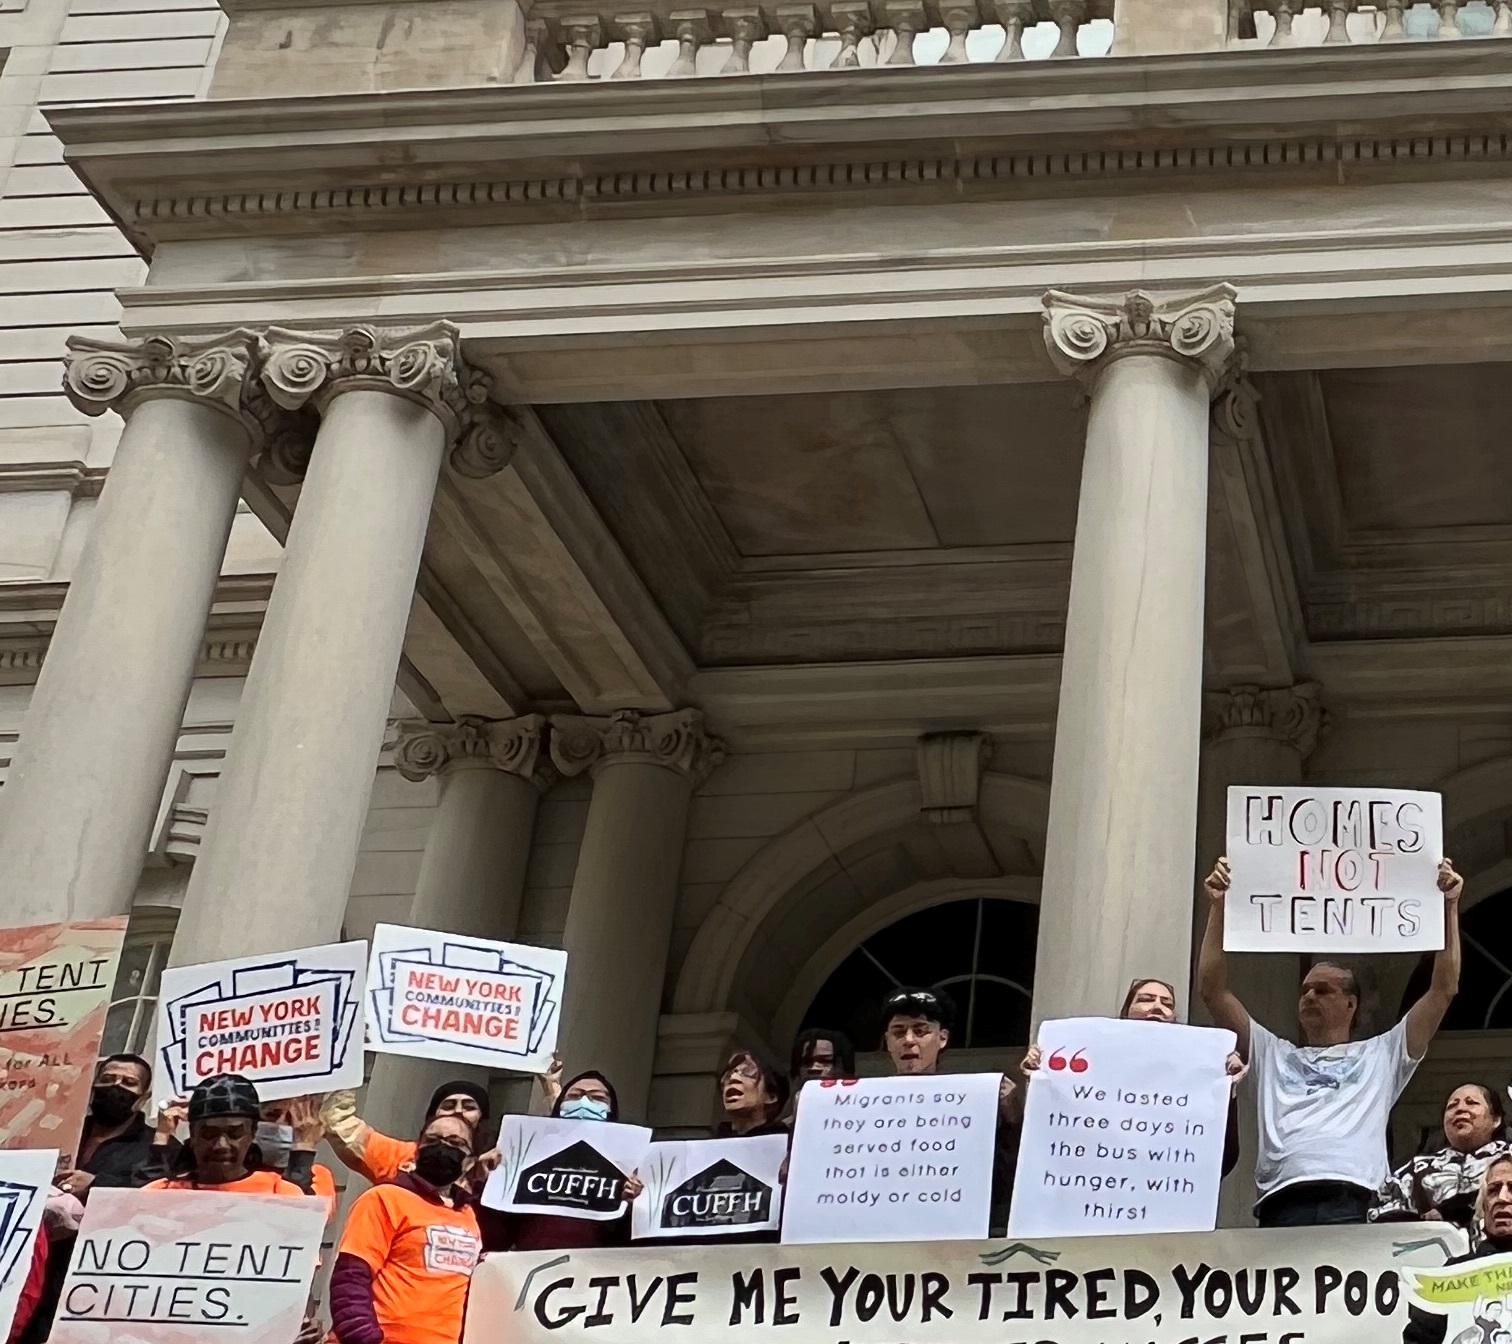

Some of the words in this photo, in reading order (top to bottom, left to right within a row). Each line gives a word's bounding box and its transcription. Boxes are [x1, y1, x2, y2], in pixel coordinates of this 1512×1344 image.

[1246, 795, 1426, 853] HOMES
[1299, 849, 1395, 891] NOT
[1250, 894, 1422, 937] TENTS
[17, 959, 109, 992] TENT
[408, 970, 458, 993] NEW
[465, 977, 523, 1002] YORK
[199, 1005, 254, 1033] NEW
[258, 995, 321, 1023] YORK
[401, 1003, 520, 1040] CHANGE
[38, 1053, 73, 1067] ALL
[195, 1034, 321, 1077] CHANGE
[834, 1093, 925, 1109] Migrants
[1072, 1084, 1107, 1101] We
[1117, 1088, 1190, 1107] lasted
[823, 1117, 866, 1132] they
[916, 1114, 972, 1131] being
[1048, 1113, 1110, 1130] three
[1120, 1117, 1175, 1135] days
[1185, 1119, 1204, 1136] in
[834, 1140, 901, 1155] served
[910, 1138, 956, 1153] food
[1050, 1142, 1086, 1157] the
[1097, 1144, 1137, 1161] bus
[1148, 1148, 1195, 1163] with
[526, 1171, 619, 1201] CUFFH
[1044, 1170, 1136, 1193] hunger,
[1146, 1177, 1195, 1194] with
[672, 1191, 762, 1217] CUFFH
[817, 1188, 880, 1207] moldy
[888, 1191, 909, 1203] or
[918, 1188, 962, 1203] cold
[1083, 1203, 1147, 1220] thirst
[78, 1239, 150, 1271] NO
[175, 1242, 304, 1277] TENT
[534, 1271, 698, 1330] GIVE
[728, 1266, 801, 1327] ME
[820, 1265, 954, 1327] YOUR
[1171, 1262, 1303, 1319] YOUR
[1314, 1263, 1400, 1317] POO
[1431, 1274, 1481, 1293] MAKE
[65, 1283, 244, 1320] CITIES.
